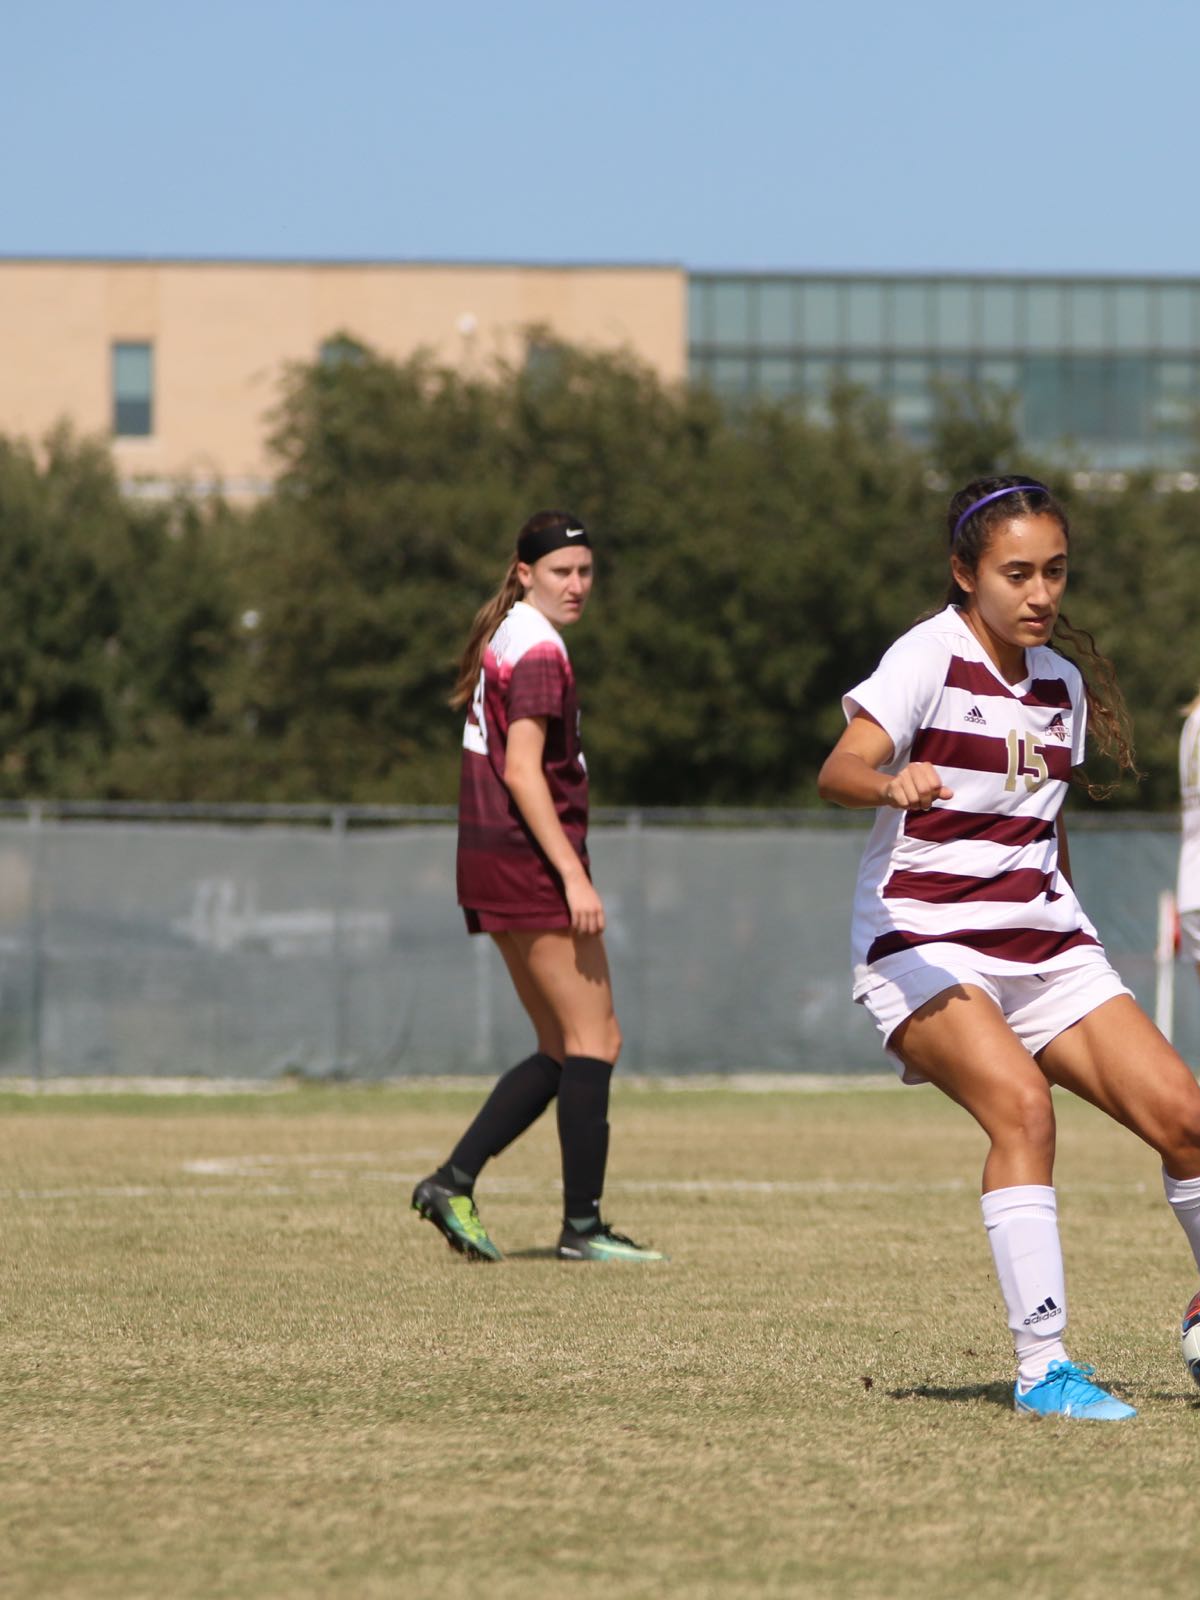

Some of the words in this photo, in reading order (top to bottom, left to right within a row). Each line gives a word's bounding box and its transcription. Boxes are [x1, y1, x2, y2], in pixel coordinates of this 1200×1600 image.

[964, 715, 987, 726] adidas
[1004, 728, 1049, 793] 15
[1023, 1307, 1062, 1326] adidas
